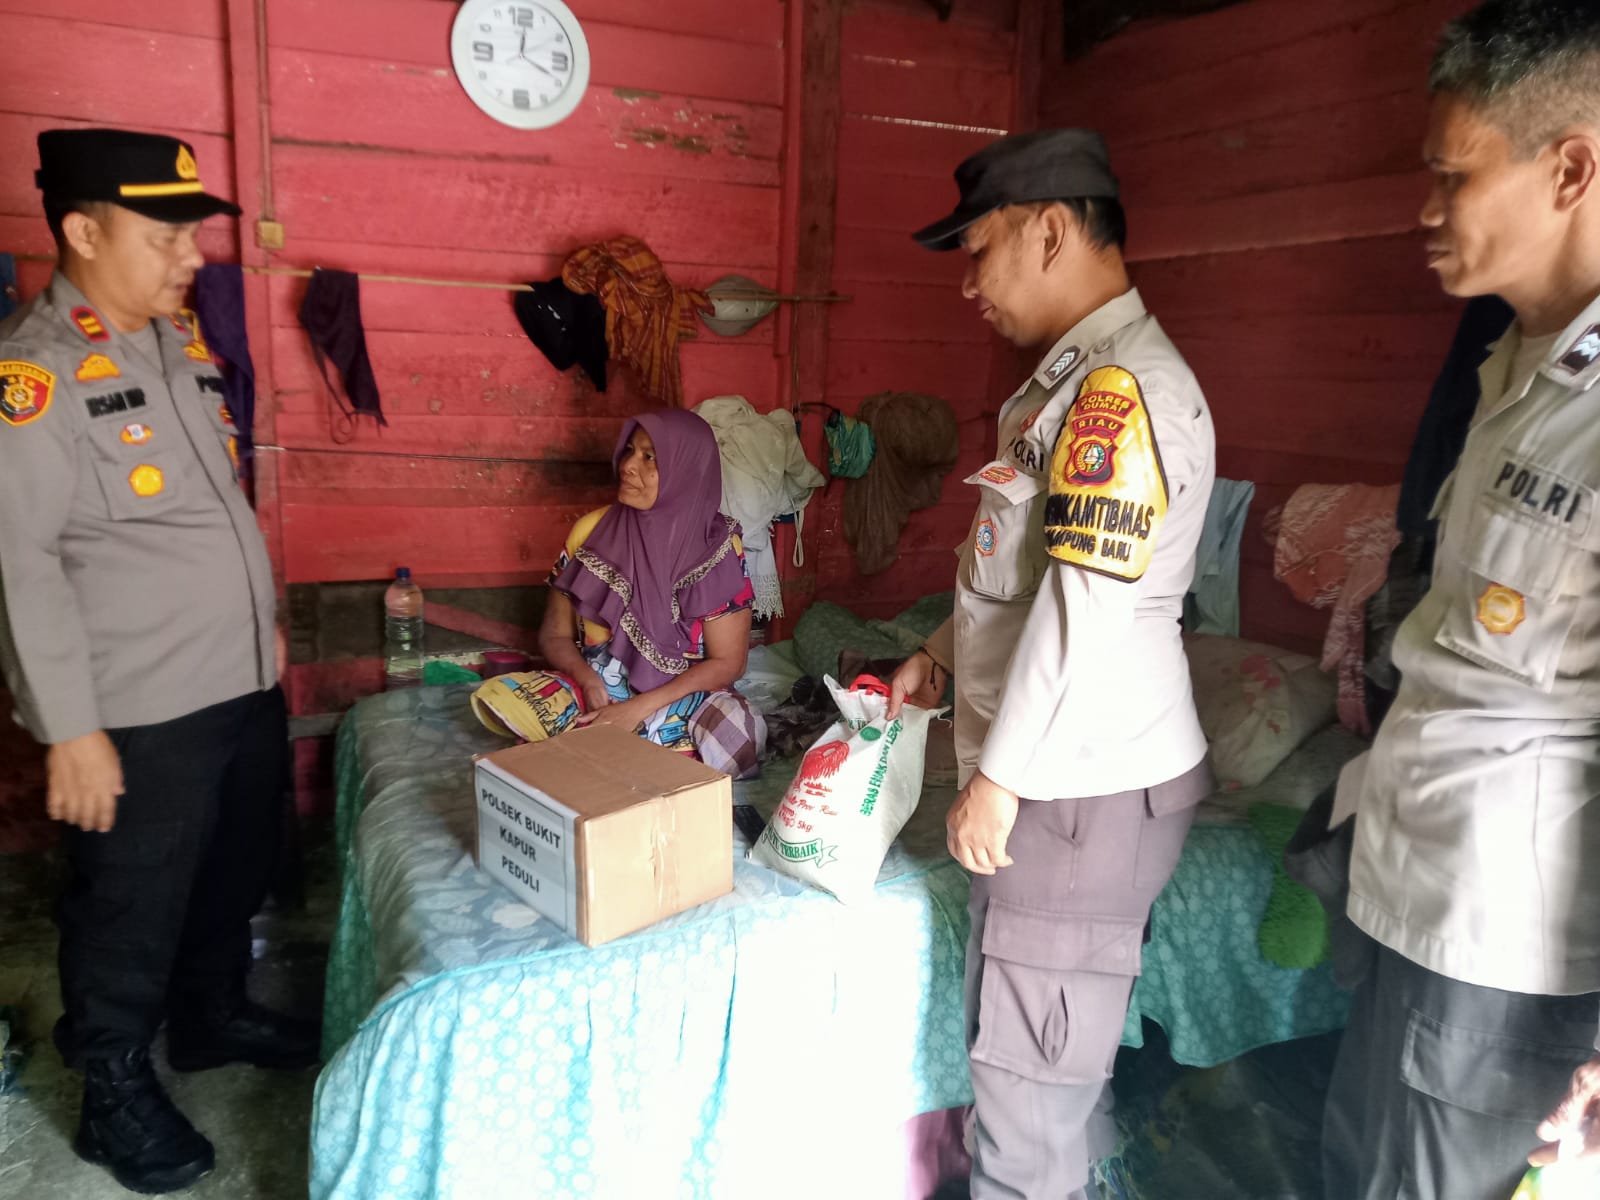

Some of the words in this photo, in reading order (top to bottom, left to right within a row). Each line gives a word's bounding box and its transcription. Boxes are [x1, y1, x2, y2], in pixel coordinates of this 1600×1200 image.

[508, 5, 534, 29] 12
[472, 40, 494, 63] 9
[551, 50, 569, 73] 3
[1078, 418, 1118, 430] RIAU
[1494, 459, 1582, 524] POLRI
[1100, 538, 1132, 562] BARU
[481, 788, 523, 825] POLSEK
[525, 815, 561, 849] BUKIT
[499, 825, 537, 862] KAPUR
[780, 842, 819, 858] TERBAIK
[501, 855, 540, 893] PEDULI
